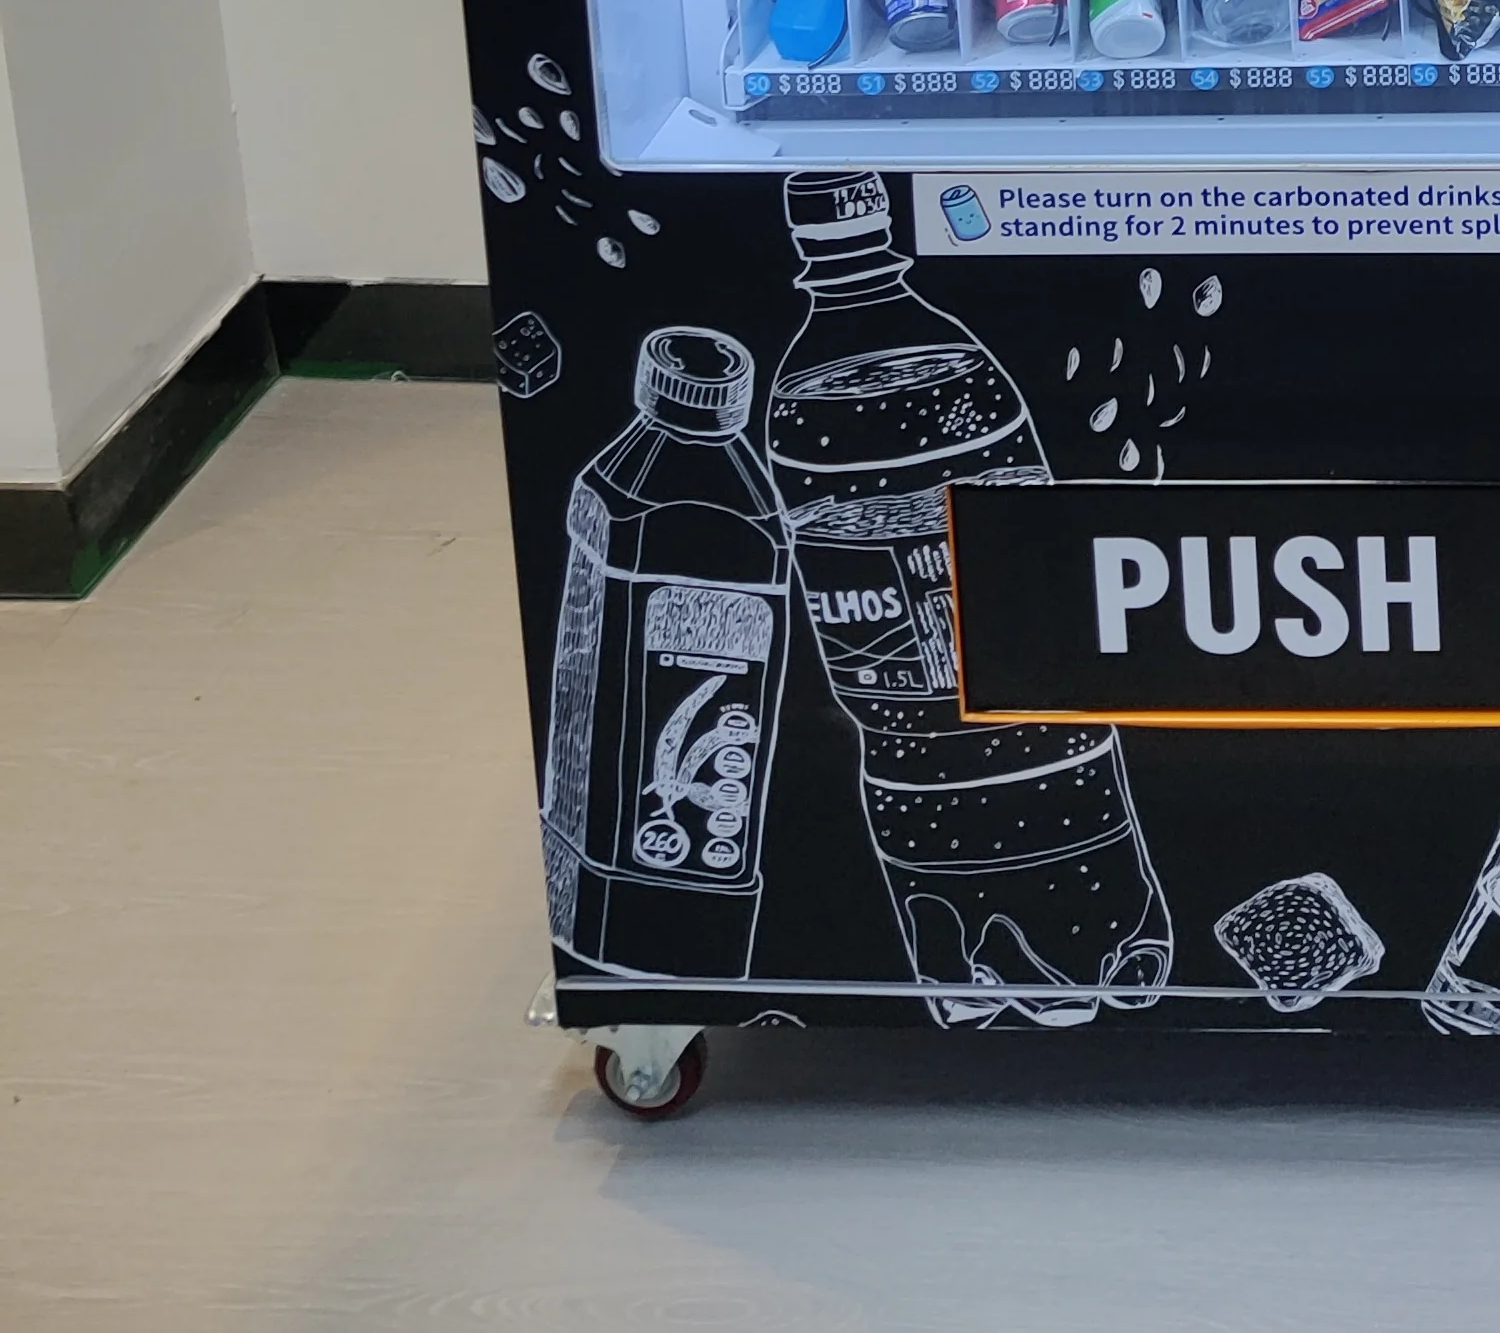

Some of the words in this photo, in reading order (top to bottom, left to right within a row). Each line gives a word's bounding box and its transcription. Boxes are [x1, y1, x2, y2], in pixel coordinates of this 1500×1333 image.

[1000, 188, 1086, 208] Please
[1094, 189, 1151, 207] turn
[1160, 192, 1193, 207] on
[1200, 186, 1246, 207] the
[1254, 185, 1408, 207] carbonated
[1000, 215, 1118, 241] standing
[1125, 215, 1164, 236] for
[1171, 216, 1186, 235] 2
[1194, 214, 1304, 235] minutes
[1313, 216, 1339, 235] to
[1348, 216, 1453, 239] prevent
[1093, 535, 1441, 658] PUSH
[881, 668, 925, 691] 1.5L
[642, 830, 682, 854] 260
